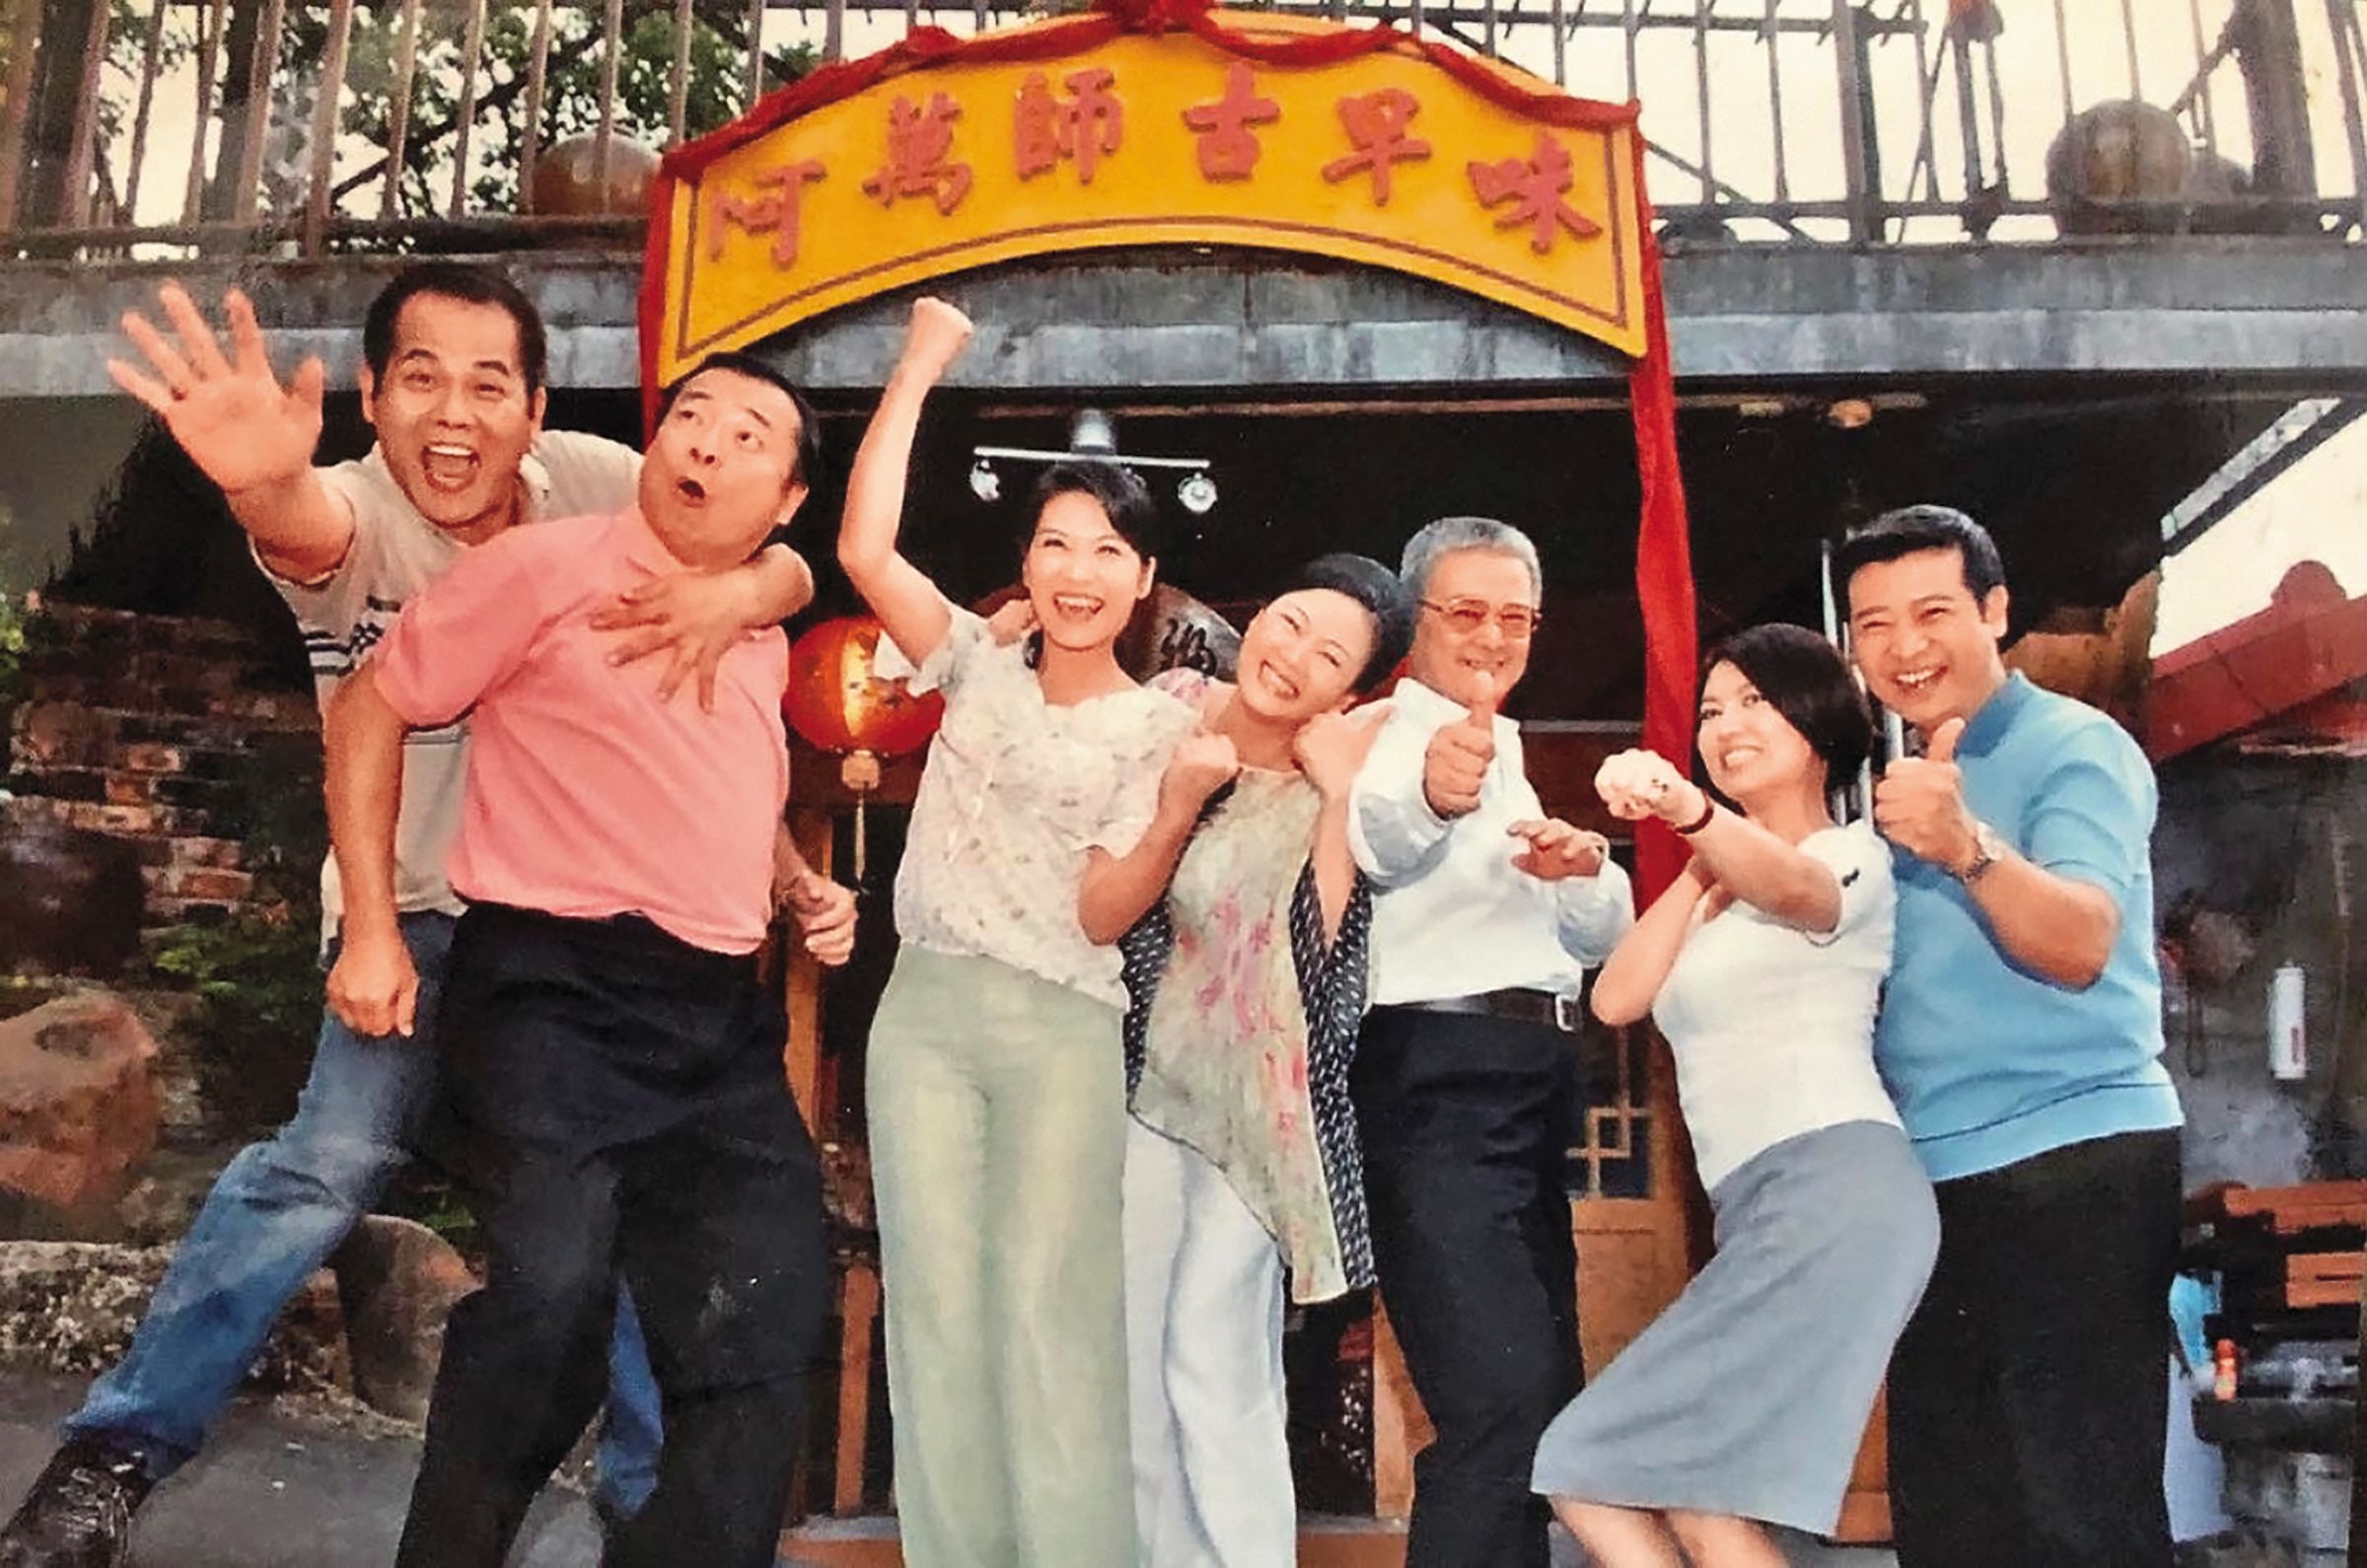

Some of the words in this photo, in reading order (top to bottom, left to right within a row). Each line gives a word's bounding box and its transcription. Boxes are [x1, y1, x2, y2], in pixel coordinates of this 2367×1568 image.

[708, 60, 1604, 270] 阿萬師古早味
